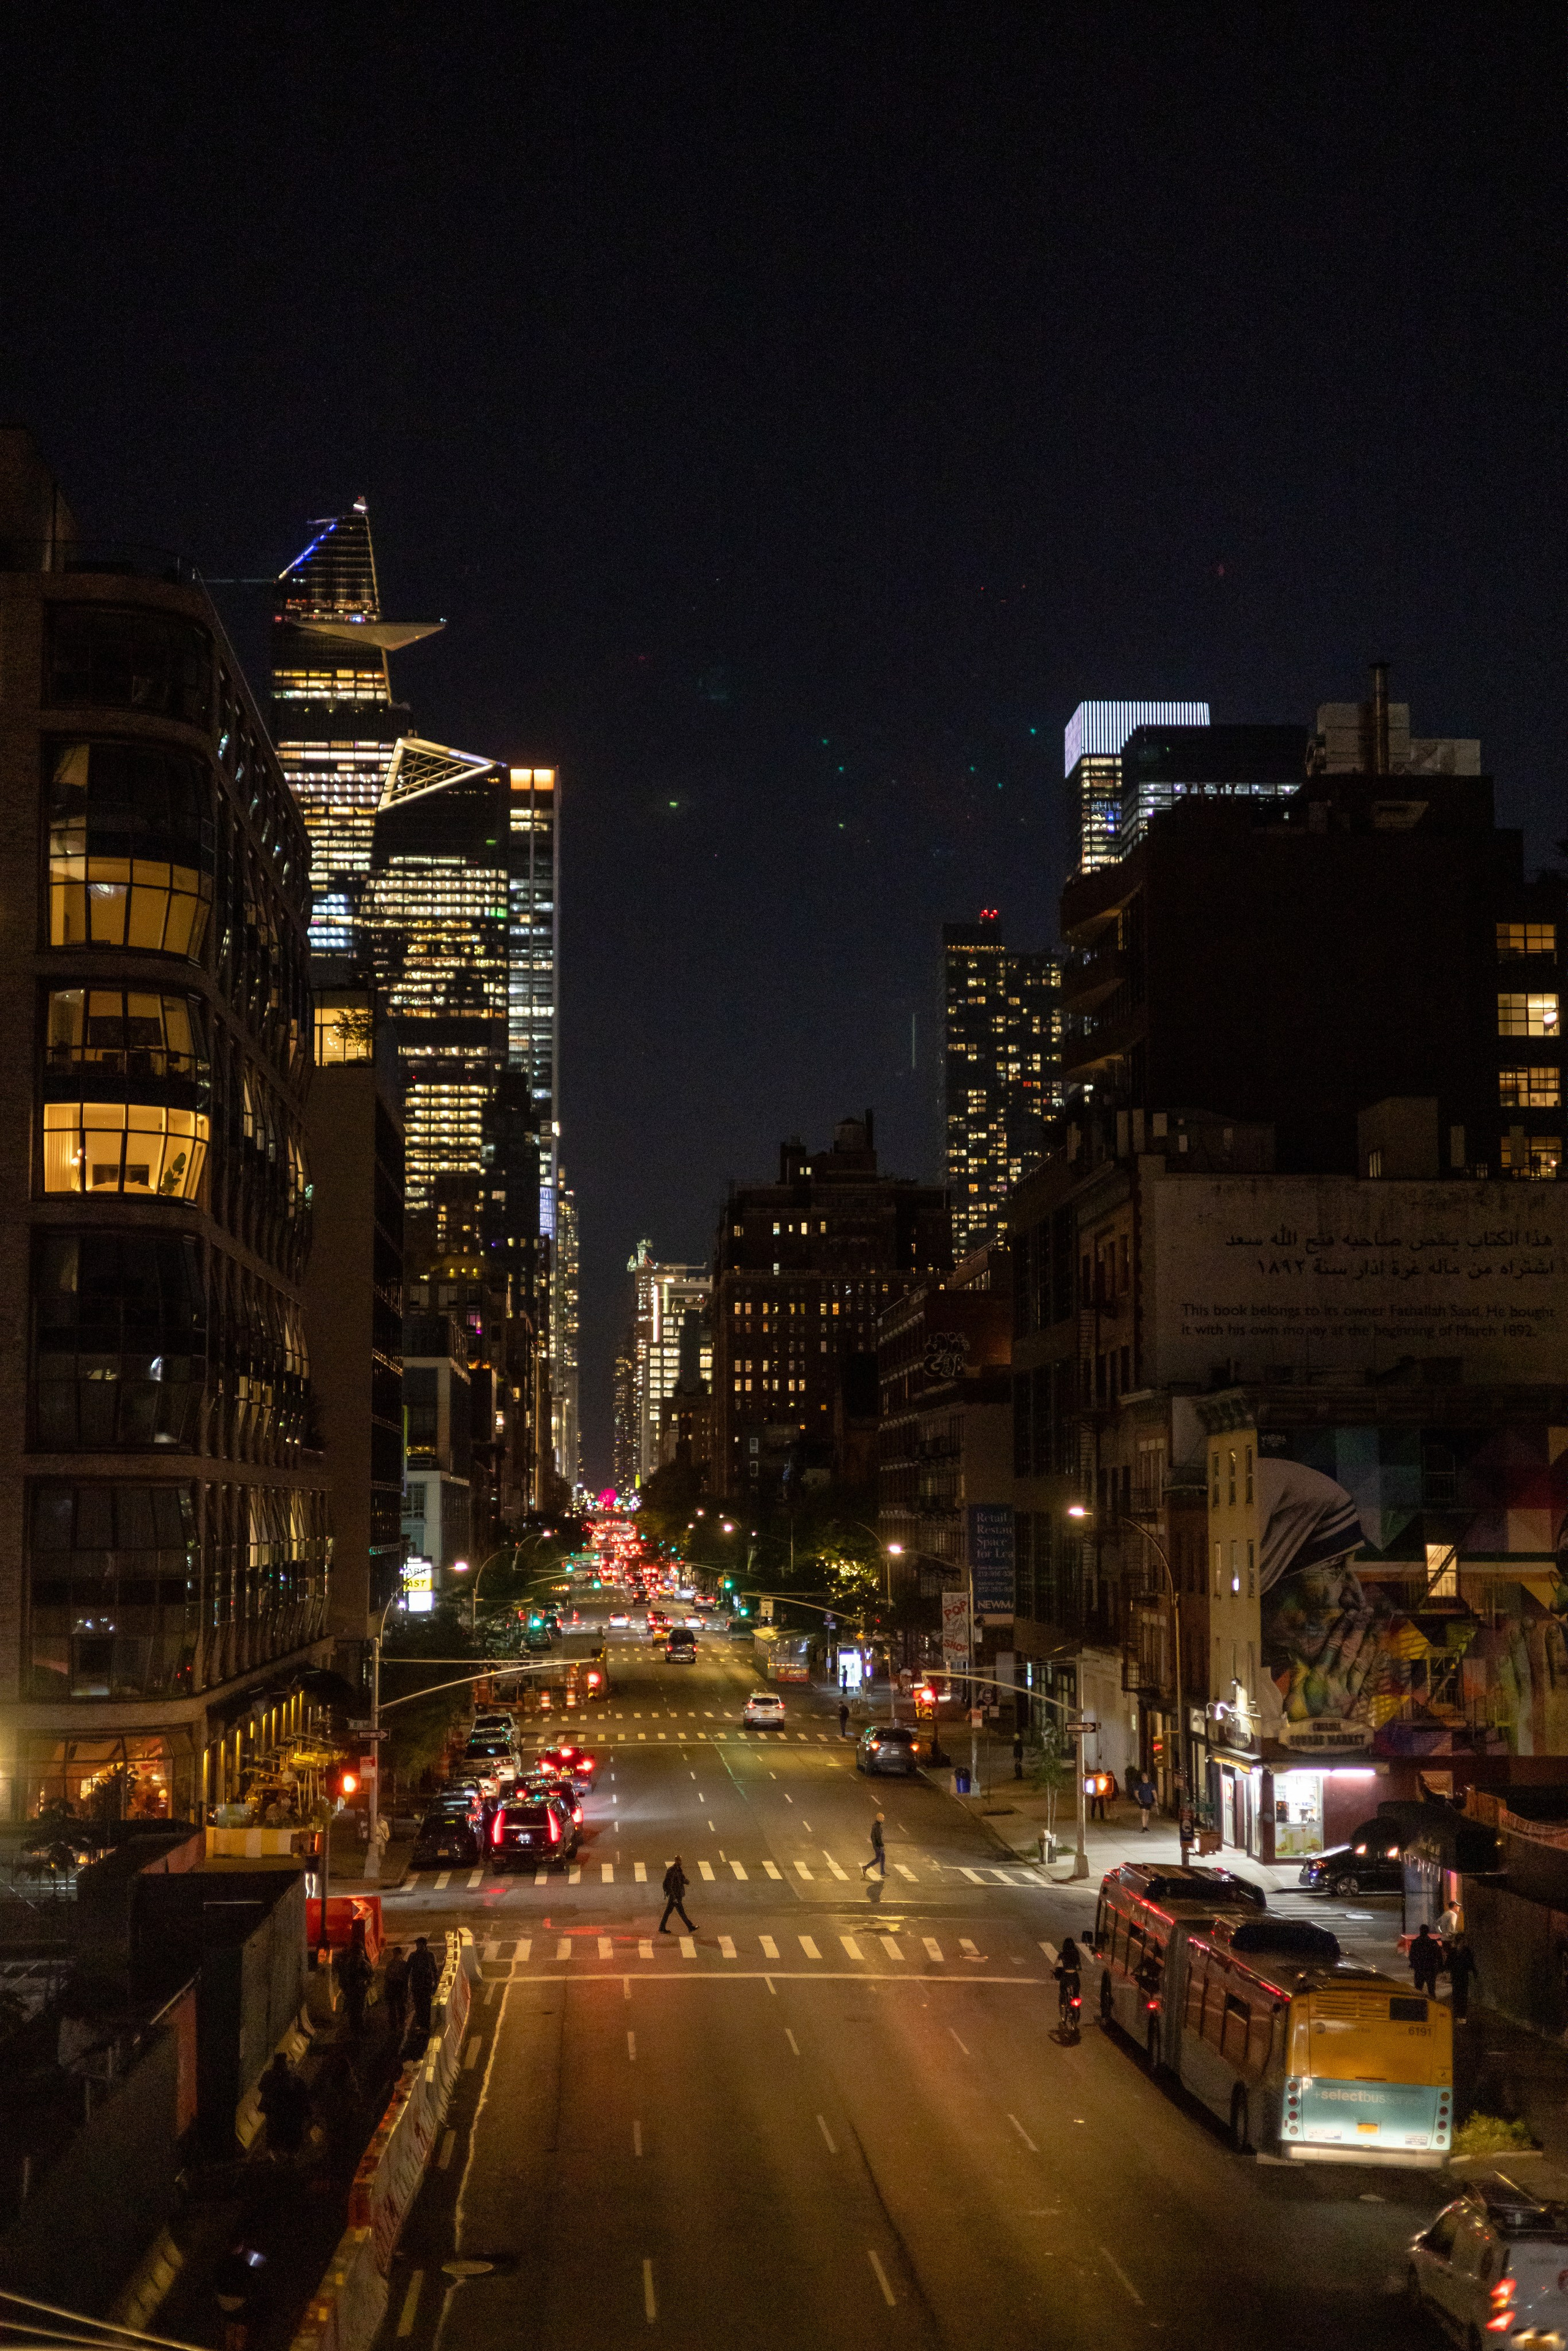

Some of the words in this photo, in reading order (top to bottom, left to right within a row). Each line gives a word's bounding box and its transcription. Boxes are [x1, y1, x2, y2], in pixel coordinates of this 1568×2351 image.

[1182, 1303, 1209, 1317] This
[1213, 1304, 1248, 1317] book
[1251, 1304, 1301, 1319] belongs
[1305, 1307, 1321, 1317] to
[1324, 1305, 1339, 1317] its
[1343, 1307, 1385, 1318] owner
[1390, 1304, 1447, 1318] Fathallah
[1487, 1305, 1506, 1318] He
[1510, 1305, 1556, 1321] bought
[1181, 1323, 1191, 1335] it
[1194, 1323, 1223, 1336] with
[1227, 1323, 1246, 1336] his
[1250, 1327, 1279, 1336] own
[1283, 1327, 1327, 1340] money
[1331, 1326, 1344, 1337] at
[1348, 1324, 1370, 1337] the
[1374, 1324, 1435, 1340] beginning
[1439, 1324, 1455, 1337] of
[1456, 1324, 1496, 1337] March
[977, 1512, 1007, 1523] Retail
[977, 1536, 1008, 1550] Space
[977, 1549, 993, 1558] for
[944, 1600, 967, 1621] POP
[943, 1639, 968, 1653] SHOP
[1408, 2026, 1432, 2037] 6191
